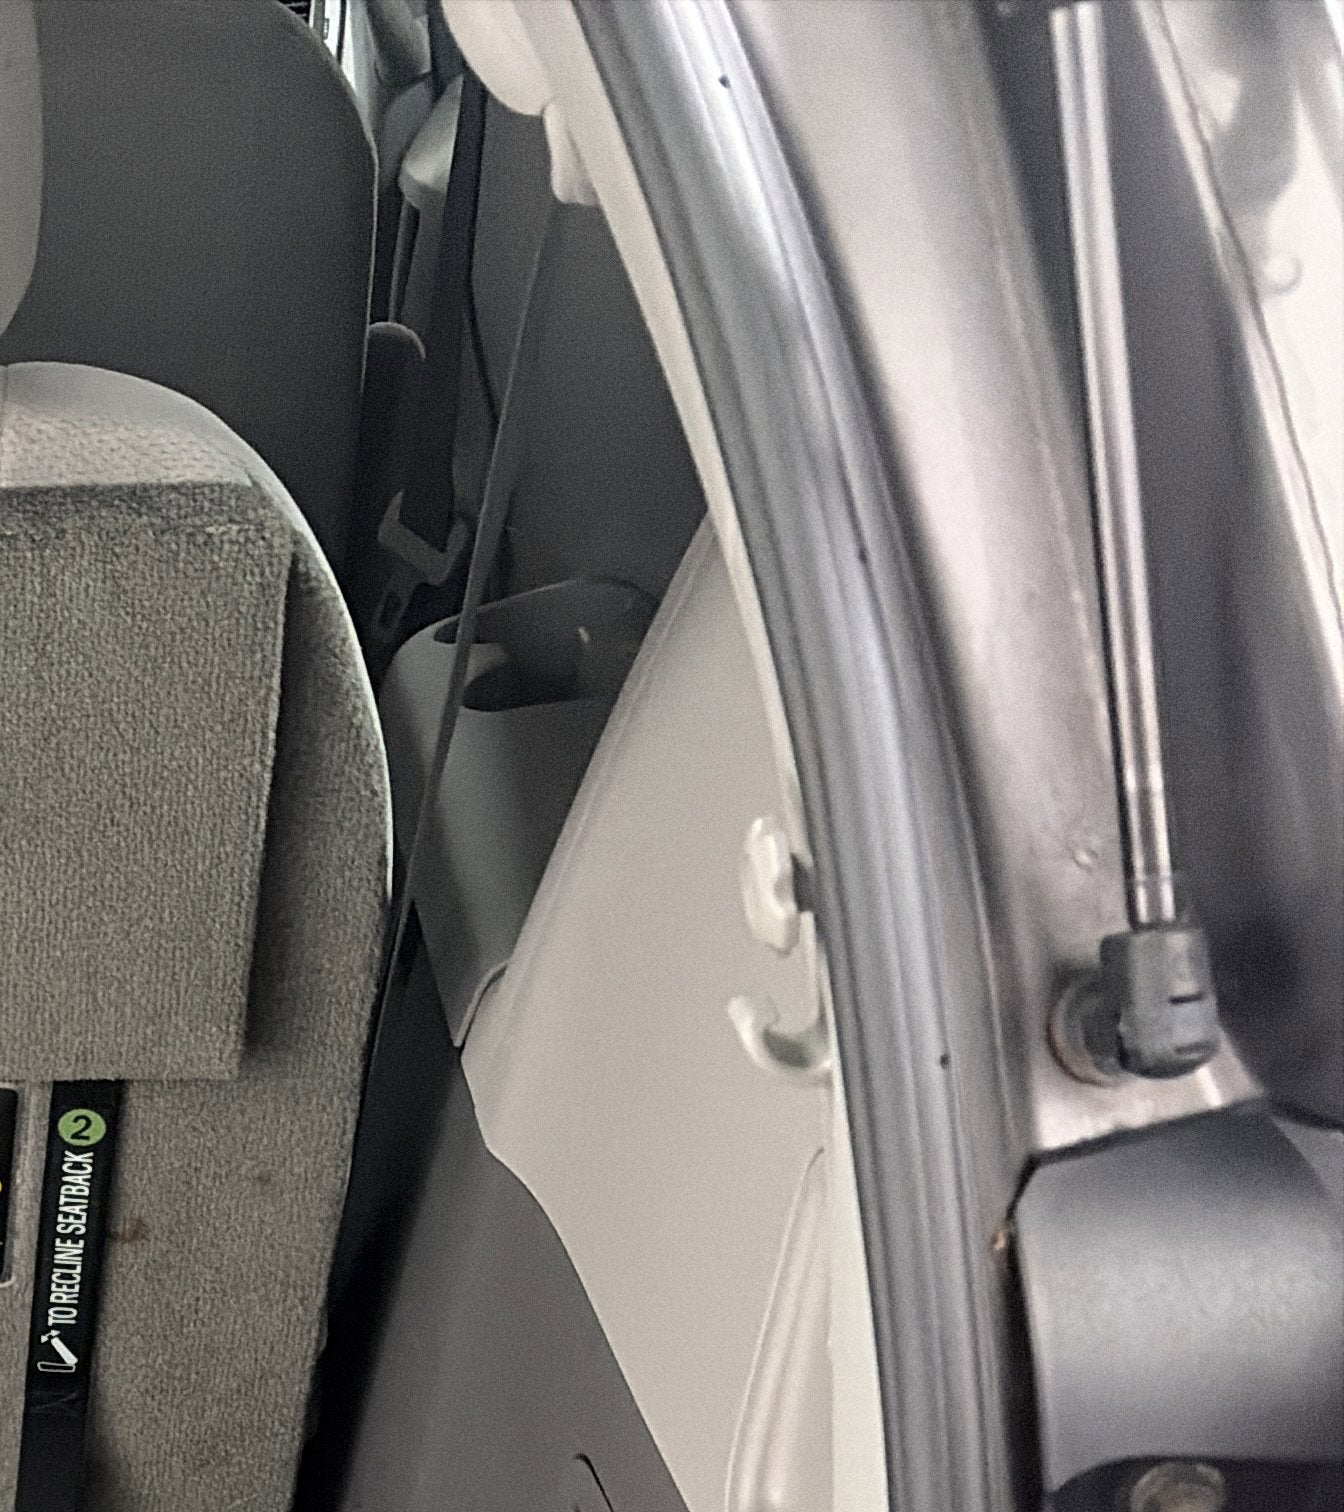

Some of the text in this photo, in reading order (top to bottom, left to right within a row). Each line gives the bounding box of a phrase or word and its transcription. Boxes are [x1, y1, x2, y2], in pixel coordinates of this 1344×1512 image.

[71, 1114, 92, 1141] 2
[47, 1150, 95, 1326] TO RECLINE SEATBACK
